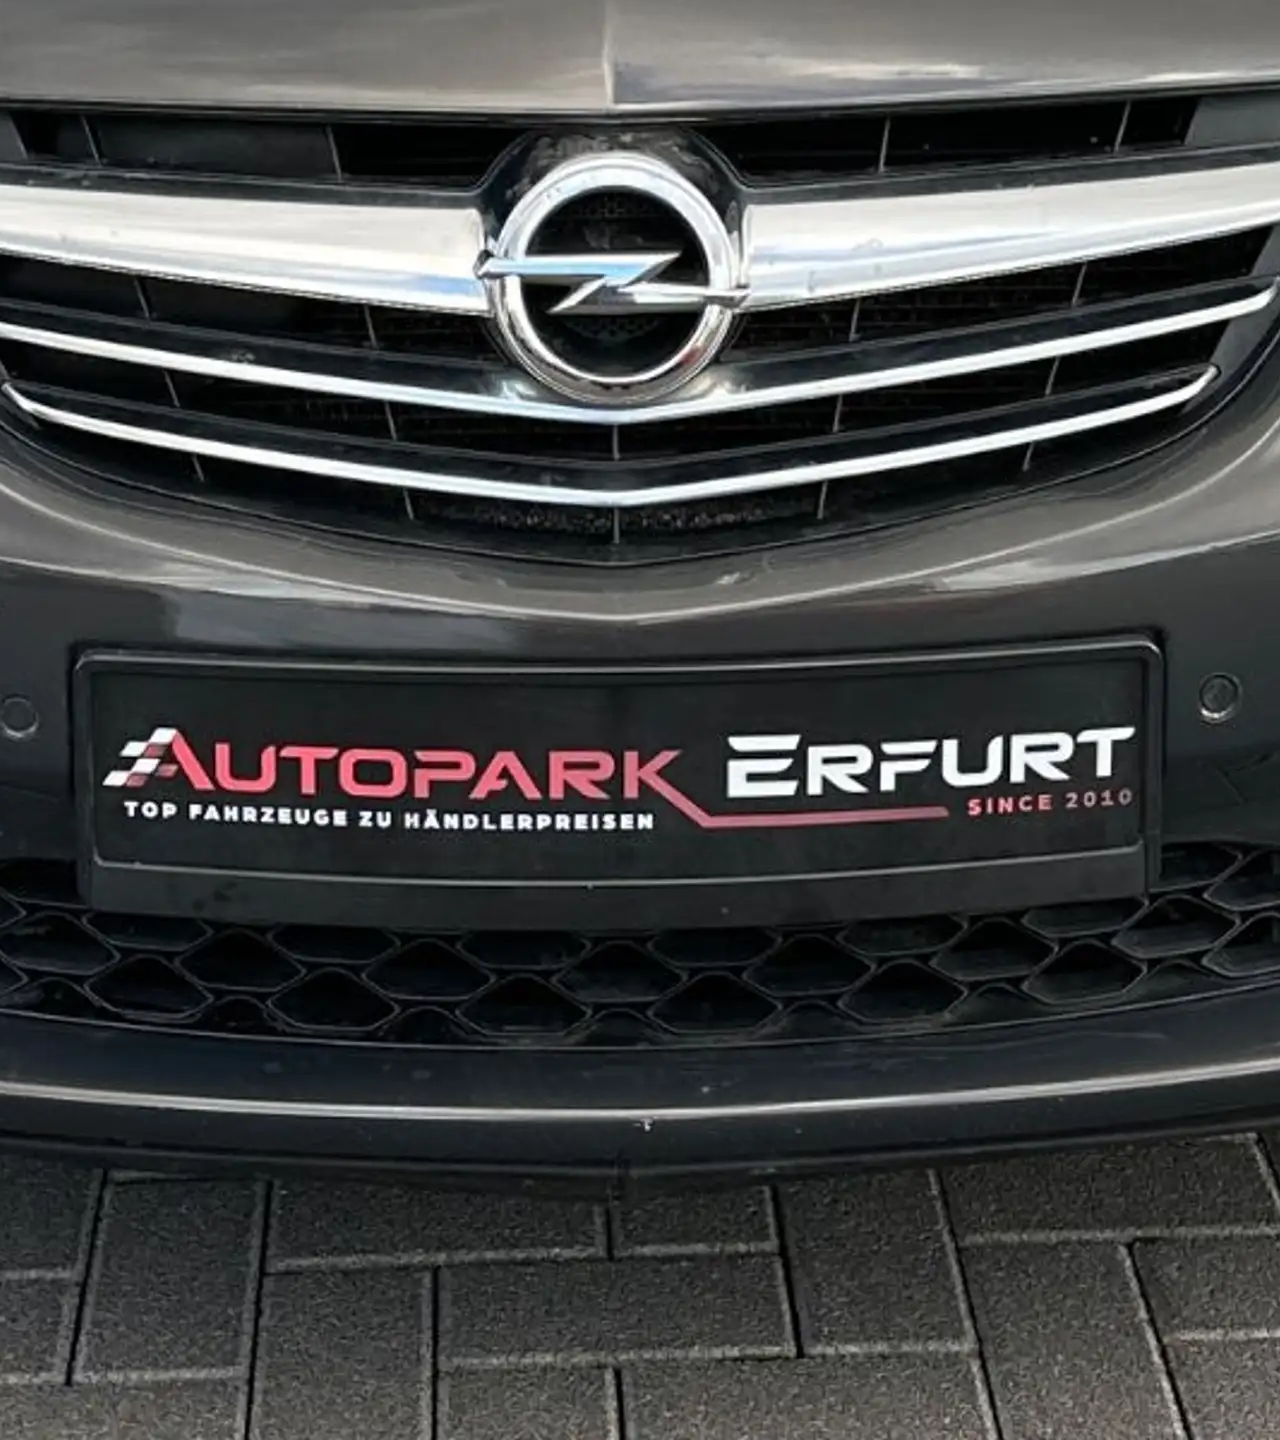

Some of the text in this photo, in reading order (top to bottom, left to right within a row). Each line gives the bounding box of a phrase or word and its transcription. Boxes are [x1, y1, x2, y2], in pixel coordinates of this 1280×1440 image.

[103, 726, 1136, 800] AUTOPARK ERFURT
[124, 801, 655, 832] TOP FAHRZEUGE ZU HÄNDLERPREISEN
[967, 789, 1133, 816] SINCE 2010
